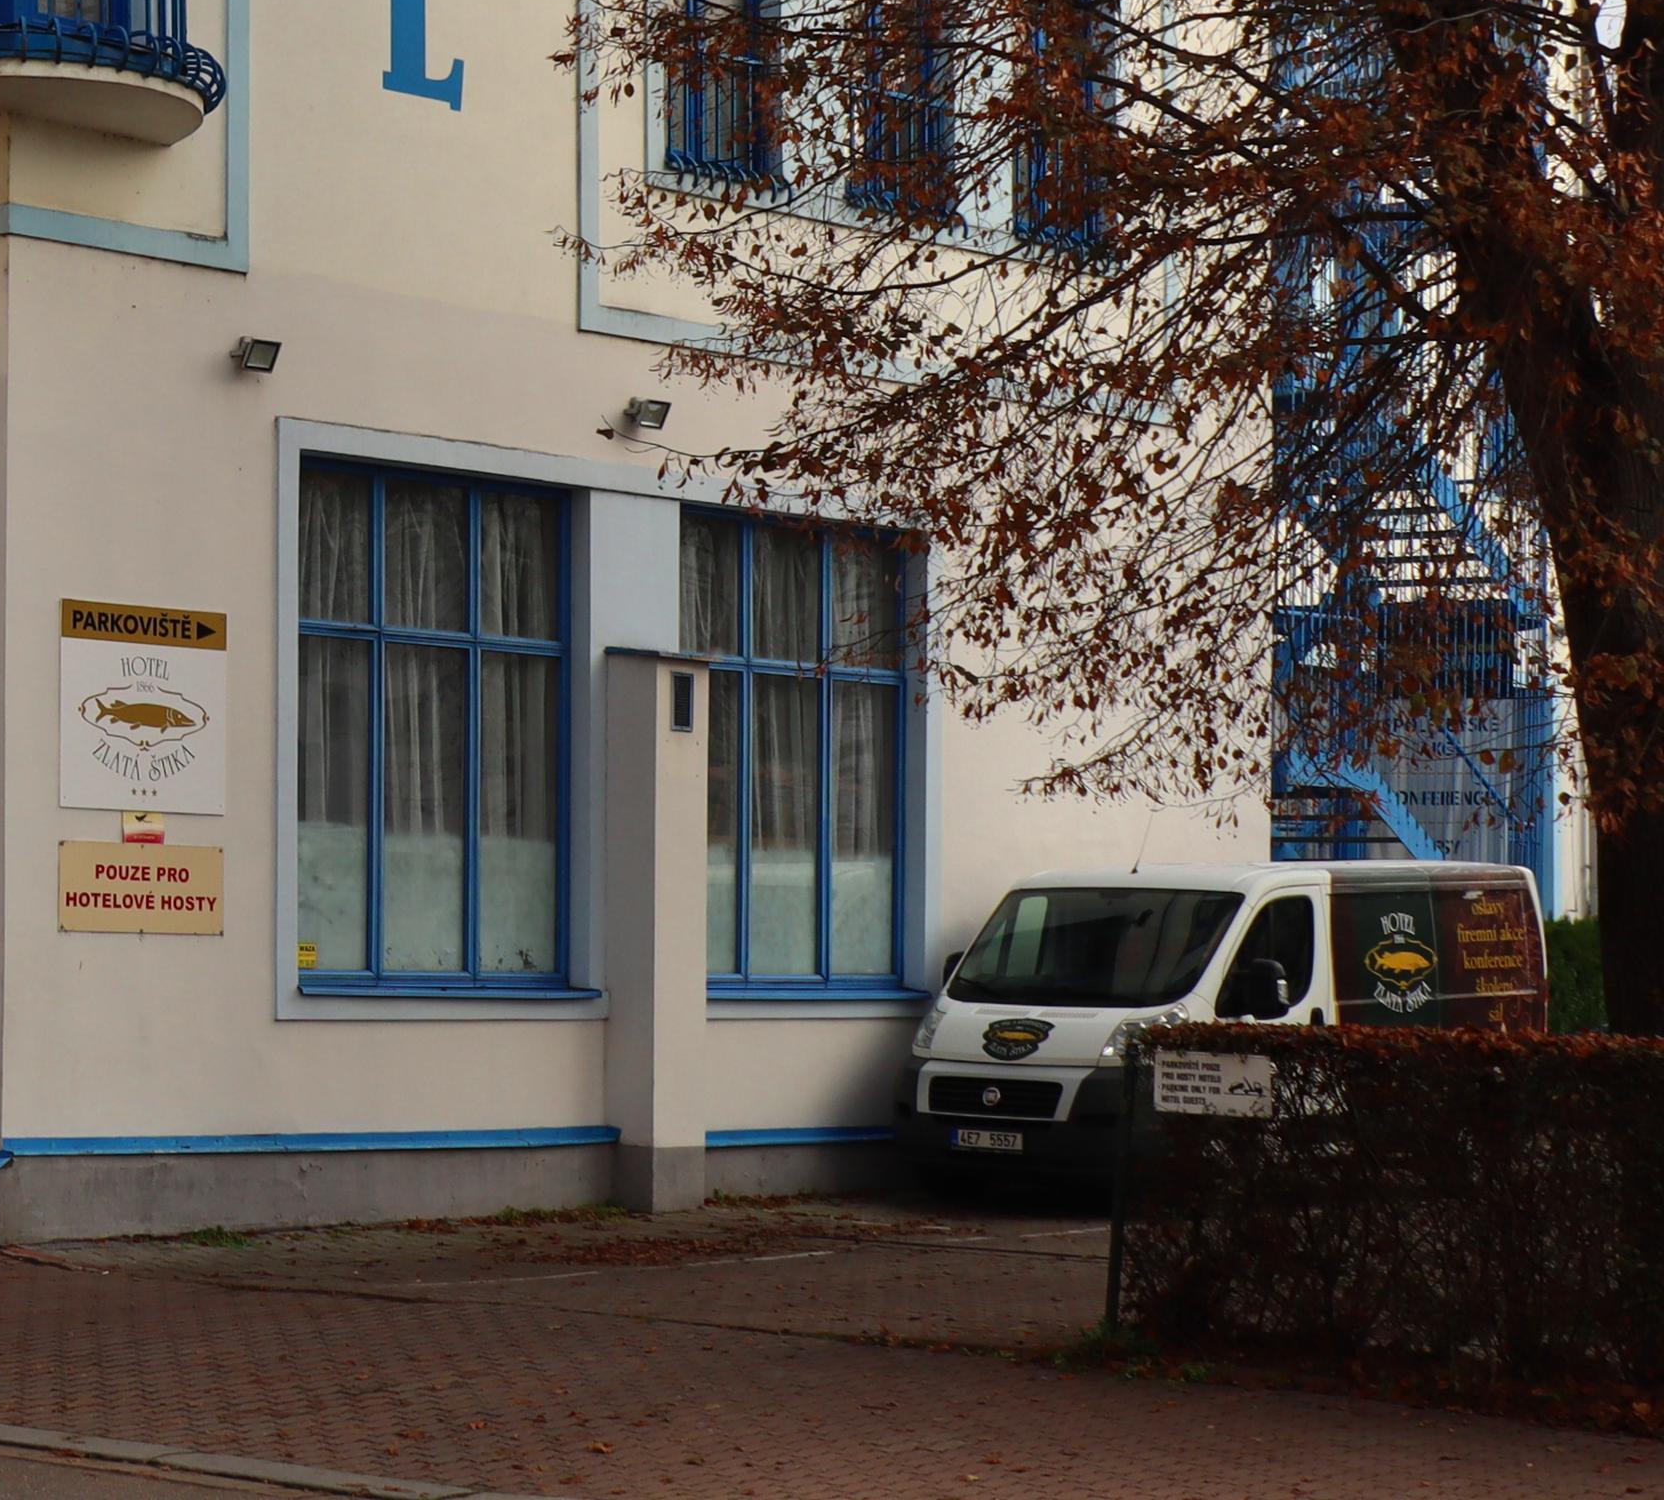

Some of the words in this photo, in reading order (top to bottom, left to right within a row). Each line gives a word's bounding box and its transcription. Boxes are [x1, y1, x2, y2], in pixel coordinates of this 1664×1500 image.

[71, 609, 192, 640] PARKOVIŠTĚ
[120, 655, 170, 681] HOTEL
[136, 680, 156, 693] 1866
[92, 738, 141, 781] ZLATÁ
[148, 744, 196, 782] ŠTIKA
[94, 863, 151, 882] POUZE
[156, 866, 190, 883] PRO
[65, 891, 155, 911] HOTELOVÉ
[160, 894, 217, 912] HOSTY
[1471, 897, 1505, 918] oslavy
[1380, 912, 1416, 936] HOTEL
[1457, 922, 1497, 942] firemní
[1499, 921, 1525, 941] akce
[1462, 949, 1523, 969] konference
[1373, 981, 1404, 1013] ZLATÁ
[1405, 980, 1433, 1013] ŠTIKA
[960, 1131, 980, 1145] 4E7
